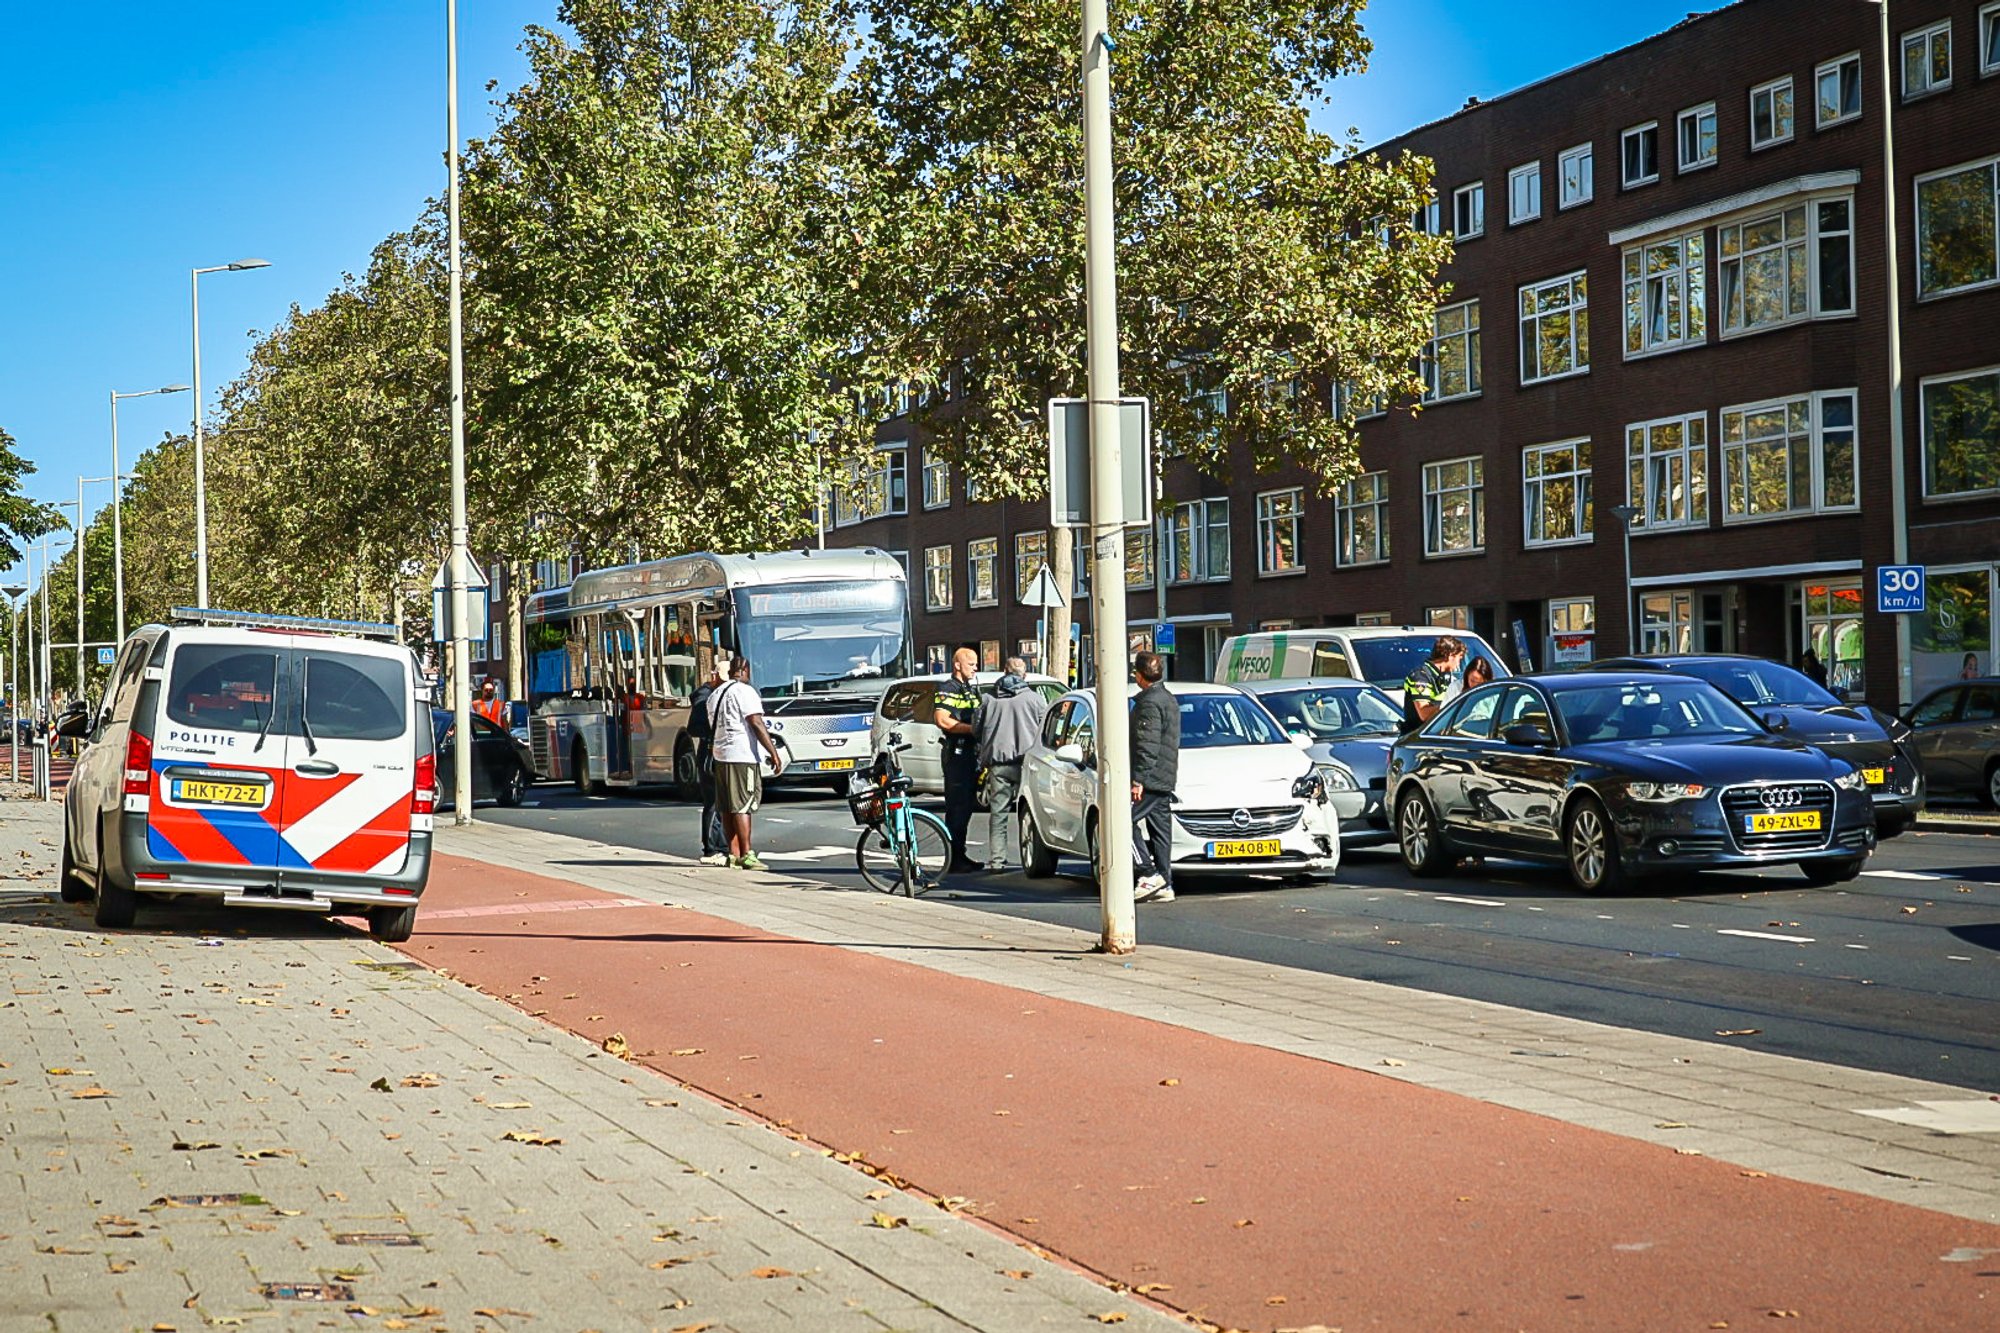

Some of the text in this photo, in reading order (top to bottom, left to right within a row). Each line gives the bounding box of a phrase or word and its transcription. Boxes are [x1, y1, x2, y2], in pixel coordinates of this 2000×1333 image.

[1883, 570, 1920, 592] 30
[1883, 595, 1920, 608] km/h
[170, 731, 236, 747] POLITIE
[187, 784, 258, 802] HKT-72-Z
[1758, 814, 1816, 830] 49-ZXL-9
[1217, 842, 1277, 856] ZN-408-N
